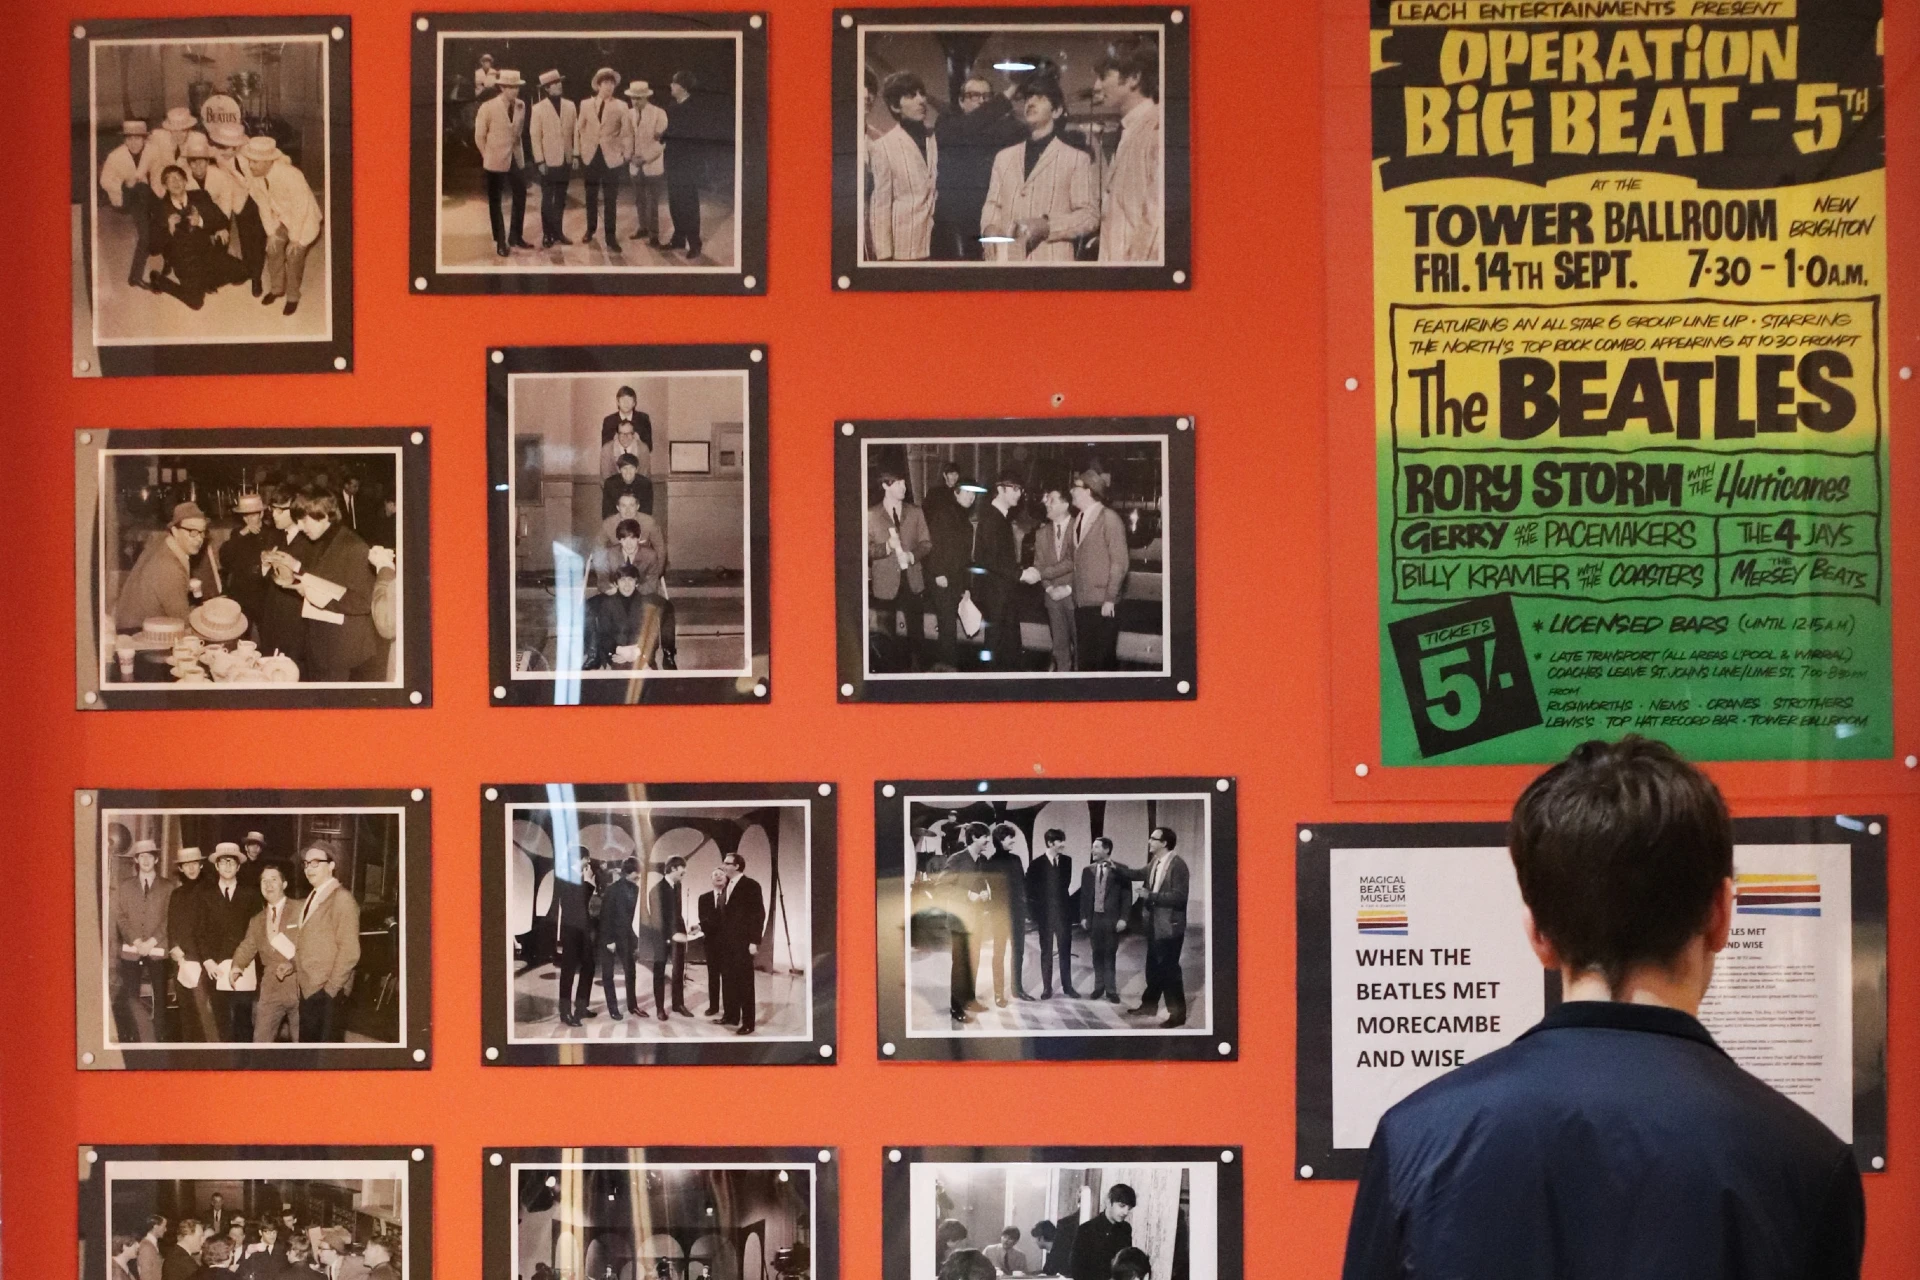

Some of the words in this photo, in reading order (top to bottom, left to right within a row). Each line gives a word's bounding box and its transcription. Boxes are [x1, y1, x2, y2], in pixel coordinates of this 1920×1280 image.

[1398, 1, 1467, 21] LEACH
[1479, 1, 1676, 20] ENTERTAINMENTS
[1691, 1, 1784, 16] PRESENT
[1550, 87, 1739, 157] BEAT
[1591, 179, 1610, 191] AT
[1615, 177, 1642, 191] THE
[1813, 195, 1860, 213] NEW
[1405, 202, 1594, 247] TOWER
[1605, 199, 1778, 243] BALLROOM
[1789, 215, 1876, 238] BRIGHTON
[1415, 253, 1471, 292] FRI.
[1475, 252, 1543, 291] 14TH
[1554, 250, 1638, 290] SEPT.
[1413, 318, 1509, 334] FEATURING
[1512, 317, 1540, 331] AN
[1541, 319, 1567, 330] ALL
[1569, 318, 1604, 331] STAR
[1607, 315, 1621, 330] 6
[1626, 316, 1682, 328] GROUP
[1683, 314, 1720, 328] LINE
[1723, 315, 1749, 328] UP
[1760, 313, 1852, 329] STARRING
[1409, 338, 1440, 355] THE
[1442, 338, 1514, 355] NORTH'S
[1521, 340, 1552, 353] TOP
[1553, 338, 1594, 352] ROCK
[1650, 335, 1735, 350] APPEARING
[1737, 335, 1757, 348] AT
[1799, 334, 1862, 347] PROMPT
[1408, 360, 1488, 438] The
[1500, 349, 1857, 440] BEATLES
[1687, 462, 1716, 482] WITH
[1404, 463, 1523, 514] RORY
[1532, 460, 1684, 508] STORM
[1688, 478, 1713, 496] THE
[1715, 459, 1851, 508] Hurricanes
[1400, 521, 1509, 554] GERRY
[1514, 522, 1539, 536] AND
[1545, 520, 1697, 549] PACEMAKERS
[1737, 522, 1773, 544] THE
[1774, 518, 1801, 550] 4
[1804, 523, 1855, 548] JAYS
[1514, 535, 1538, 546] THE
[1577, 561, 1604, 578] WITH
[1768, 557, 1793, 566] THE
[1402, 562, 1461, 591] BILLY
[1468, 563, 1570, 590] KRAMER
[1609, 562, 1704, 589] COASTERS
[1731, 558, 1807, 587] MERSEY
[1809, 557, 1868, 588] BEATS
[1580, 576, 1601, 590] THE
[1424, 619, 1490, 645] TICKETS
[1549, 613, 1664, 635] LICENSED
[1669, 615, 1729, 635] BARS
[1738, 613, 1786, 634] (UNTIL
[1550, 650, 1583, 663] LATE
[1586, 649, 1660, 662] TRANSPORT
[1689, 650, 1729, 661] AREAS
[1547, 665, 1603, 679] COACHES
[1606, 666, 1647, 678] LEAVE
[1547, 686, 1581, 696] FROM
[1546, 699, 1634, 712] RUSHWORTHS
[1649, 698, 1690, 711] NEMS
[1706, 698, 1762, 710] CRANES
[1772, 696, 1855, 710] STROTHERS
[1605, 714, 1633, 729] TOP
[1634, 714, 1660, 728] HAT
[1660, 714, 1711, 727] RECORD
[1711, 714, 1738, 727] BAR
[1750, 714, 1799, 726] TOWER
[1800, 713, 1869, 727] BALLROOM
[1359, 875, 1406, 884] MAGICAL
[1359, 884, 1405, 894] BEATLES
[1360, 893, 1406, 903] MUSEUM
[1747, 927, 1766, 936] MET
[1742, 941, 1764, 949] WISE
[1355, 948, 1424, 967] WHEN
[1430, 948, 1472, 966] THE
[1356, 982, 1447, 1001] BEATLES
[1453, 981, 1501, 1000] MET
[1356, 1015, 1501, 1034] MORECAMBE
[1356, 1050, 1405, 1068] AND
[1411, 1049, 1465, 1067] WISE
